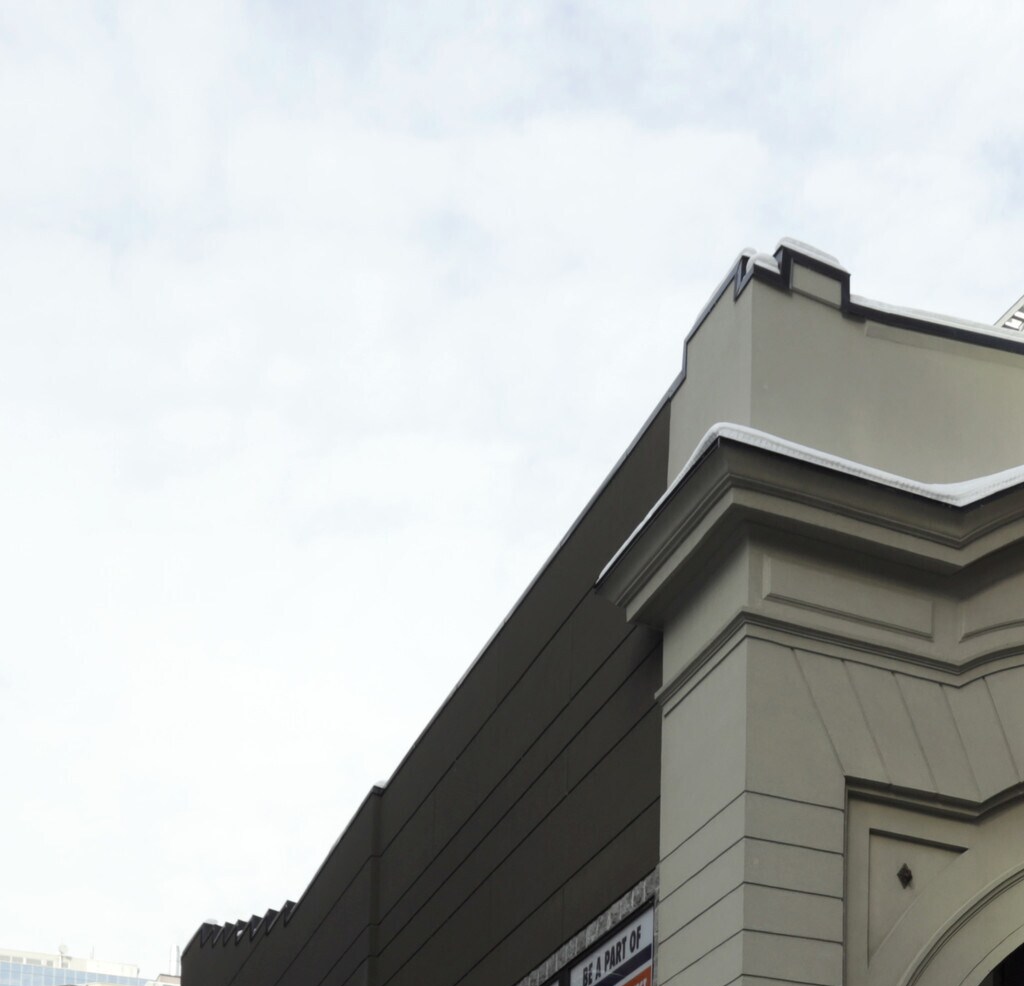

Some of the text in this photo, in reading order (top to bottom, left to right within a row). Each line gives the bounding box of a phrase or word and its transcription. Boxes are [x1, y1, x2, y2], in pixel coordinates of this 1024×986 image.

[595, 956, 602, 980] A
[604, 937, 627, 972] PART
[630, 925, 641, 953] OF
